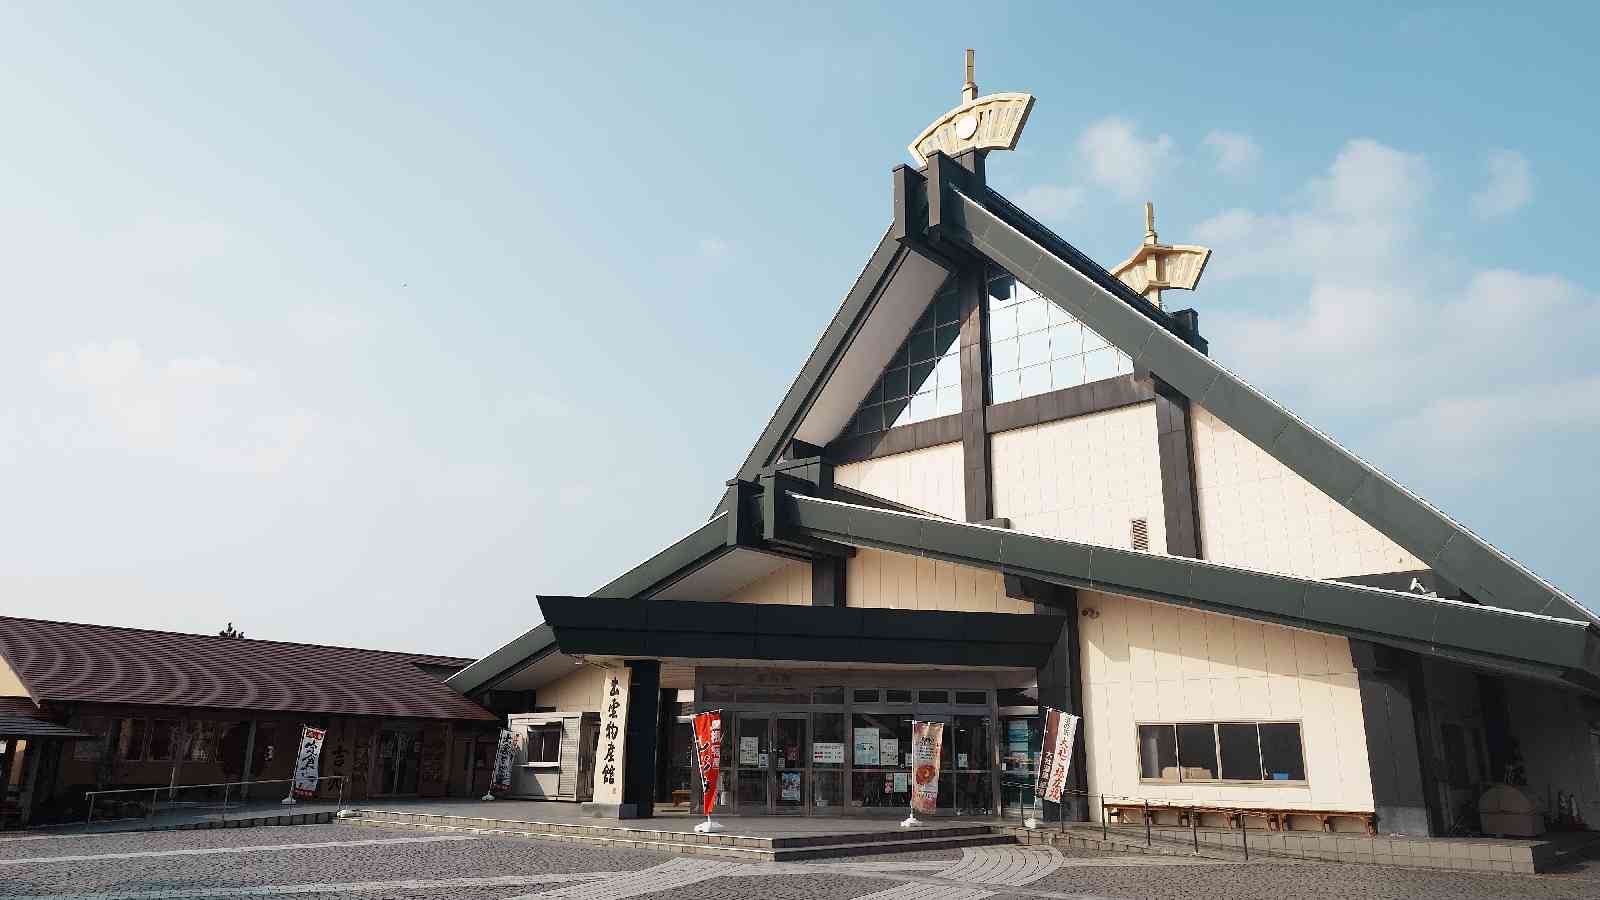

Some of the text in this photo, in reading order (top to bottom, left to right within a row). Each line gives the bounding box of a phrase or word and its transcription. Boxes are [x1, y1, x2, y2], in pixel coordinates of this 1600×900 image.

[602, 676, 620, 785] 出雲物産館
